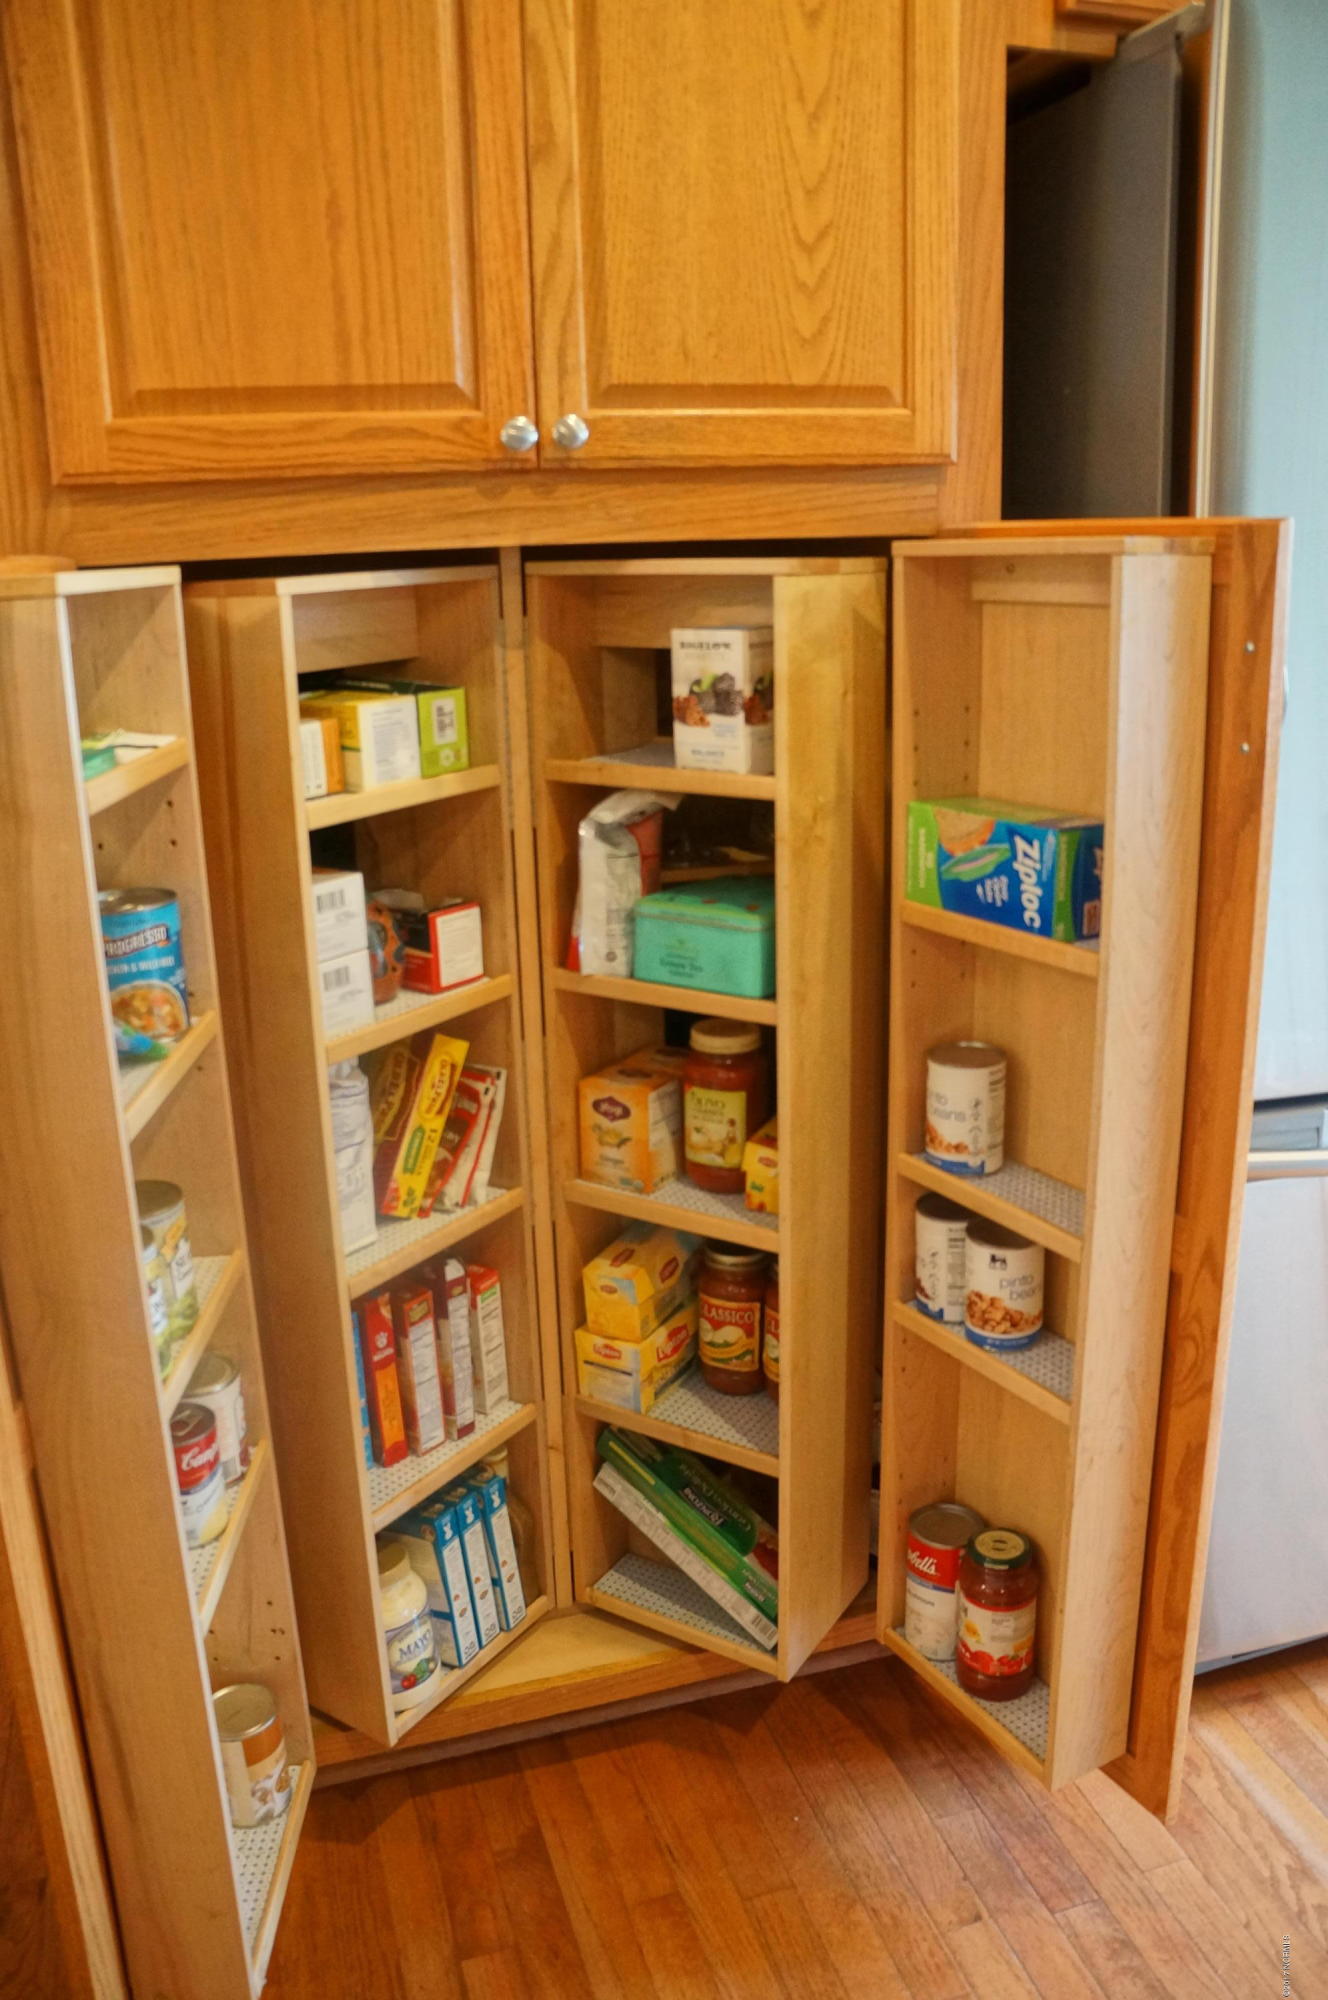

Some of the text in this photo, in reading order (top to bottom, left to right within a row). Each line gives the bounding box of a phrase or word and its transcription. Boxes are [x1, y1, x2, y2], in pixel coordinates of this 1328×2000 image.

[1013, 834, 1042, 929] Ziploc
[1009, 1286, 1039, 1302] bea
[702, 1304, 754, 1324] LASSICO
[658, 1327, 689, 1359] Lipton
